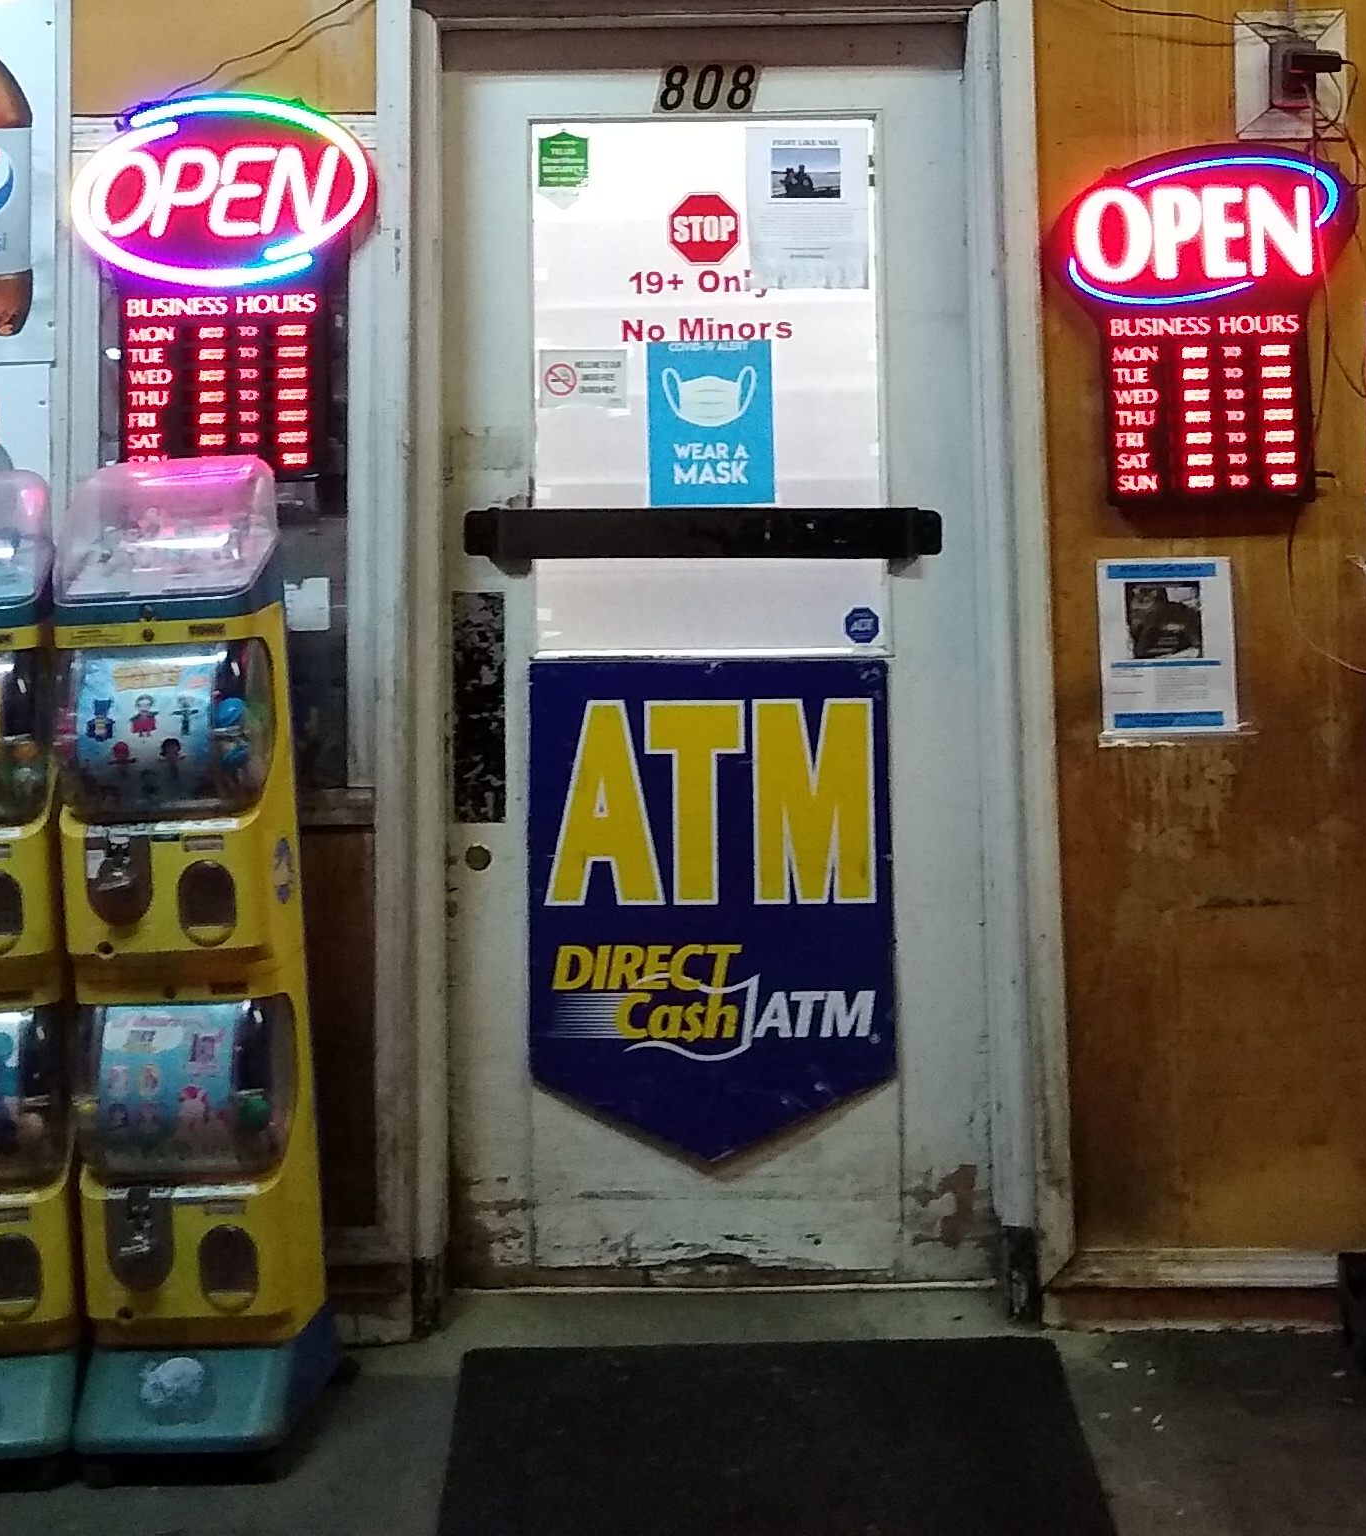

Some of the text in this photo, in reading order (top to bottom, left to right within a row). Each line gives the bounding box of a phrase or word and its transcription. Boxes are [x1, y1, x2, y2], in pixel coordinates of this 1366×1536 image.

[658, 64, 757, 112] 808
[88, 144, 341, 239] OPEN
[672, 215, 736, 244] STOP
[1074, 182, 1315, 284] OPEN
[628, 269, 768, 299] 19+ On
[125, 293, 317, 318] BUSINESS HOURS
[127, 325, 176, 342] MON
[620, 317, 794, 342] No Minors
[1108, 313, 1300, 338] BUSINESS HOURS
[127, 347, 165, 364] TUE
[1112, 344, 1160, 362] MON
[127, 368, 174, 385] WED
[1113, 367, 1149, 384] TUE
[127, 390, 170, 407] THU
[1114, 389, 1159, 405] WED
[127, 412, 157, 429] FRI
[1115, 410, 1156, 427] THU
[127, 432, 163, 449] SAT
[1116, 431, 1144, 448] FRI
[673, 442, 750, 460] WEAR A
[1117, 453, 1150, 469] SAT
[673, 459, 750, 486] MASK
[1117, 474, 1158, 491] SUN
[543, 697, 878, 907] ATM
[551, 943, 743, 991] DIRECT
[752, 989, 878, 1040] ATM
